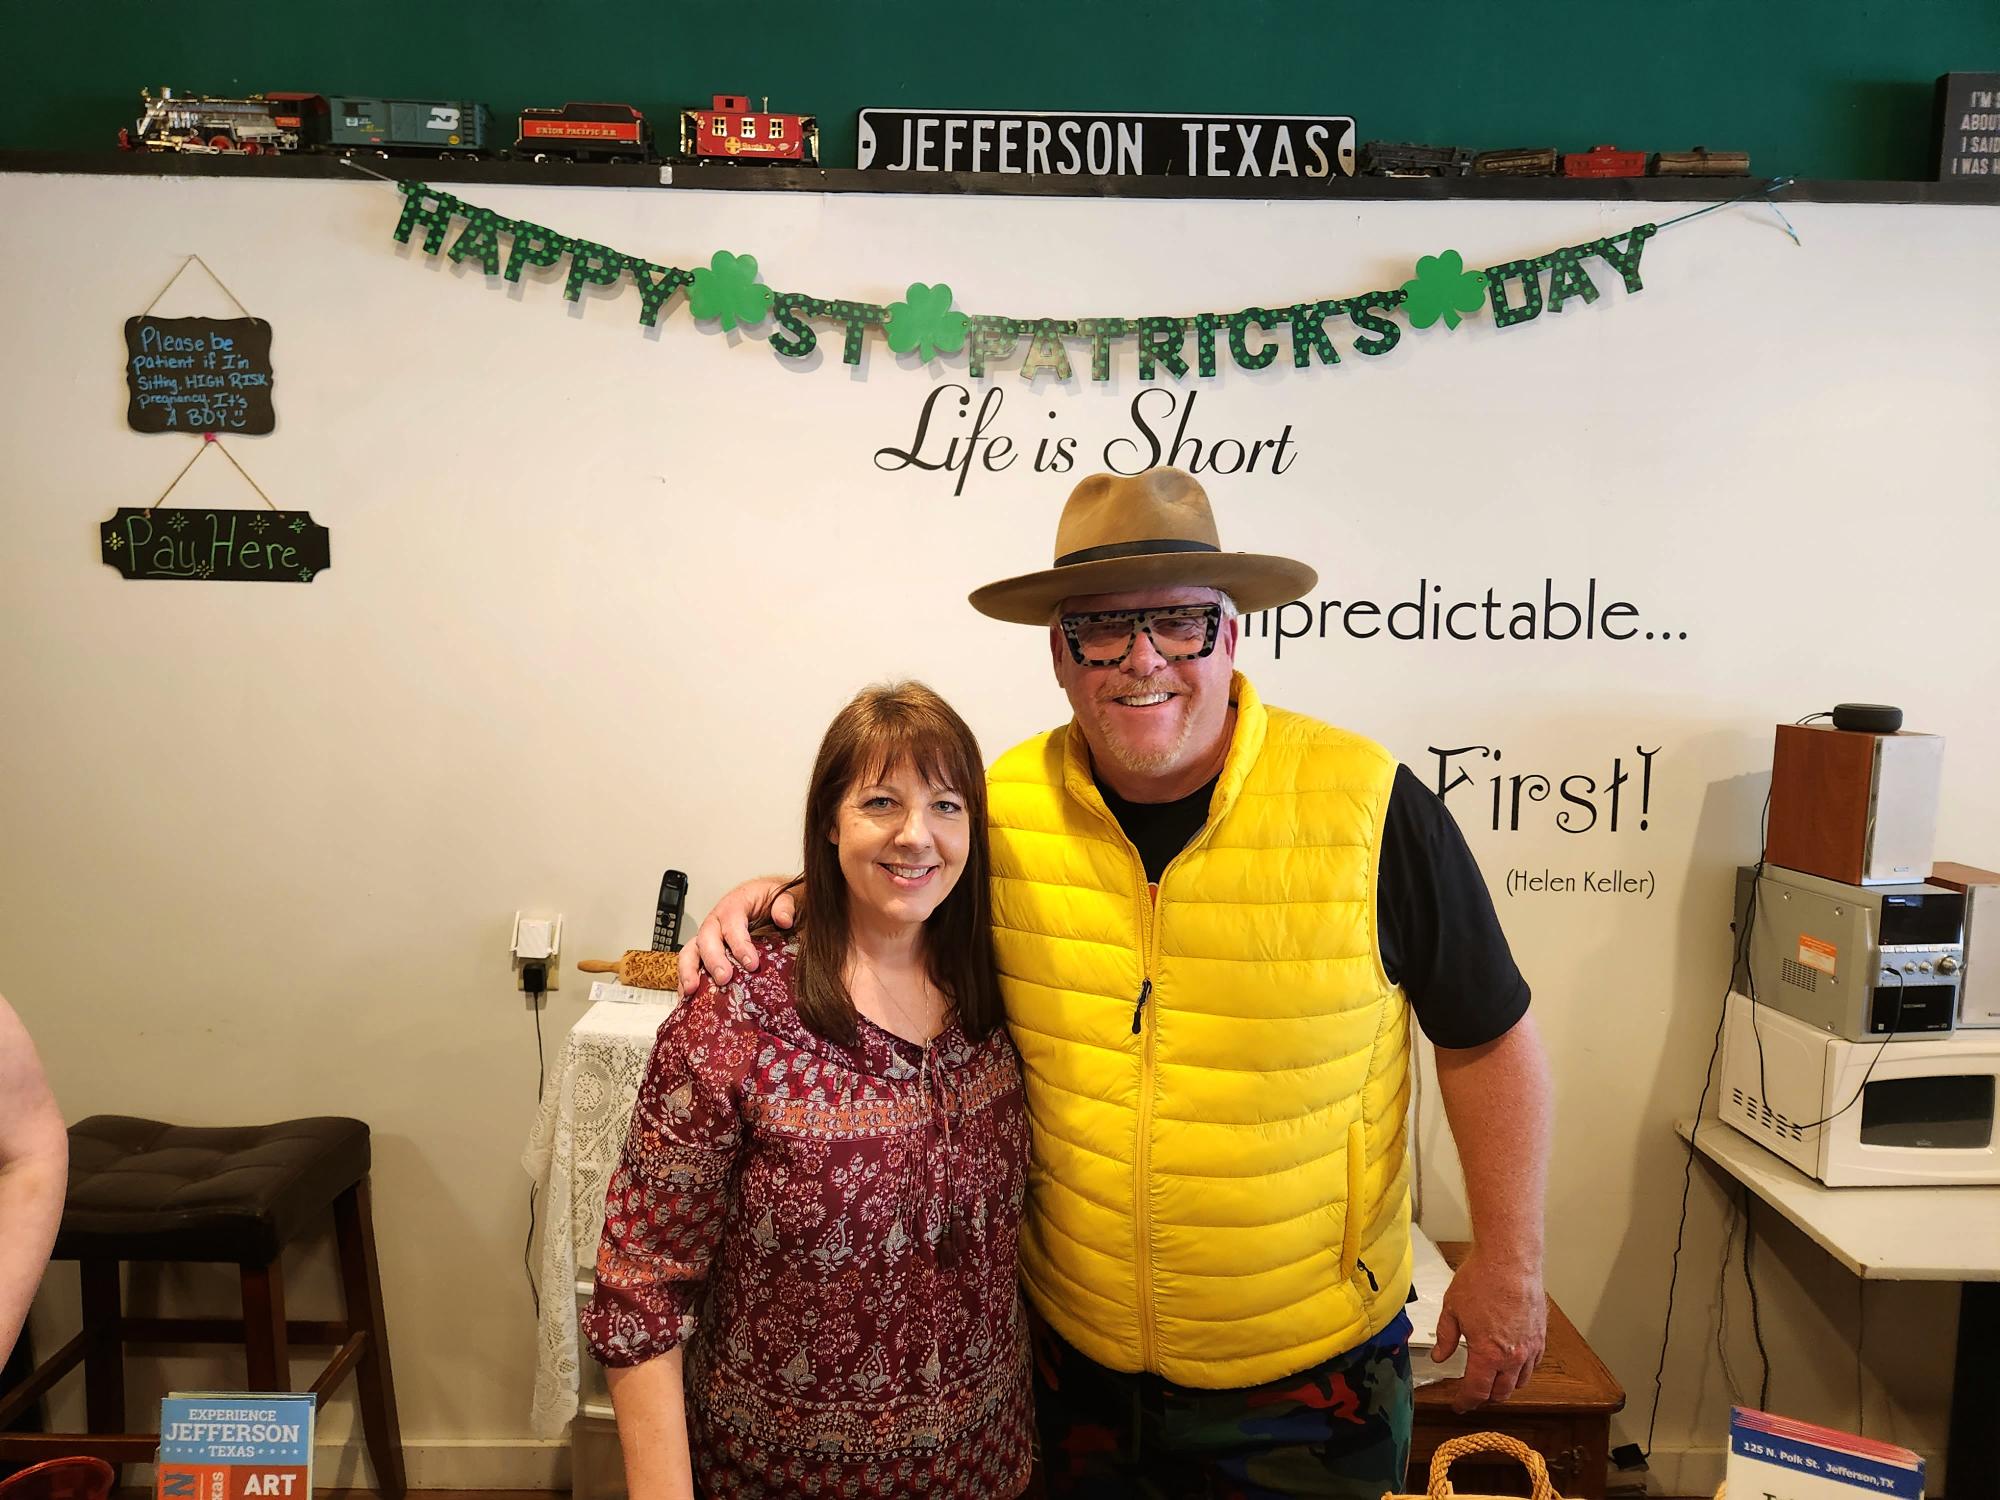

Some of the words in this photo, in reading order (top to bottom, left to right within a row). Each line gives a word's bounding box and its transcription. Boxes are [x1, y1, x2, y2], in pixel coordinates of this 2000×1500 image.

[1971, 91, 1992, 108] I'M
[536, 127, 564, 135] UNION
[886, 118, 1144, 174] JEFFERSON
[1183, 123, 1332, 178] TEXAS
[1961, 136, 1967, 153] I
[1952, 158, 1958, 175] I
[1962, 158, 1989, 175] WAS
[392, 180, 690, 328] HAPPY
[769, 292, 888, 364] ST
[965, 291, 1406, 382] PATRICKS
[1483, 224, 1657, 328] DAY
[142, 326, 205, 352] Please
[210, 331, 234, 351] be
[203, 354, 216, 369] if
[186, 375, 224, 389] HIGH
[227, 373, 268, 388] RISK
[213, 393, 248, 410] It's
[166, 409, 177, 427] A
[187, 408, 228, 428] BOY
[873, 383, 1018, 497] Life
[1033, 411, 1077, 473] is
[1103, 388, 1298, 475] Short
[126, 515, 198, 576] Pay
[206, 513, 300, 570] Here
[1244, 577, 1687, 659] npredictable...
[1428, 745, 1662, 833] First!
[1506, 868, 1575, 898] (Helen
[1584, 870, 1655, 899] Keller)
[188, 1408, 277, 1422] EXPERIENCE
[165, 1423, 300, 1443] JEFFERSON
[208, 1445, 256, 1458] TEXAS
[1743, 1441, 1764, 1455] 125
[1766, 1446, 1777, 1459] N.
[1780, 1450, 1804, 1466] Polk
[1805, 1457, 1821, 1470] St.
[243, 1473, 297, 1496] ART
